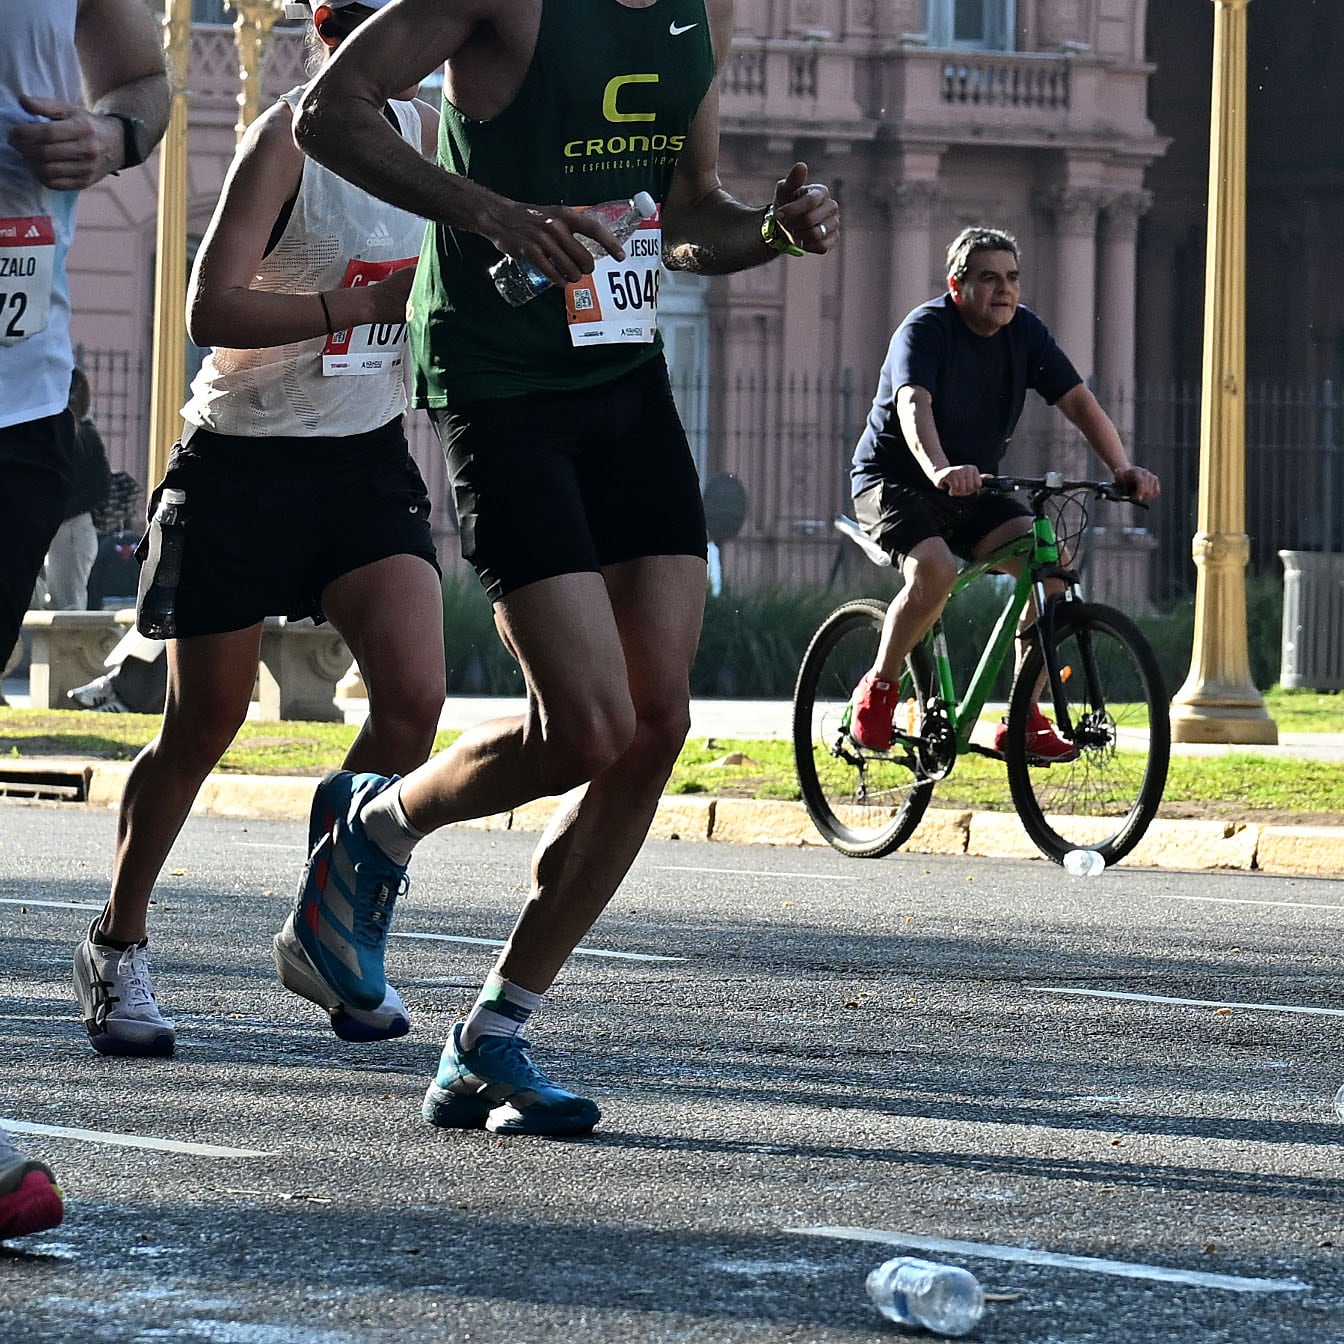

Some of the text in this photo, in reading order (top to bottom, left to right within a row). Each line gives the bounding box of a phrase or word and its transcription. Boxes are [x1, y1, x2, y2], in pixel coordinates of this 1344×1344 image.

[602, 73, 659, 123] C
[563, 135, 687, 157] CRONOS
[630, 238, 659, 258] JESUS
[367, 323, 408, 346] 107
